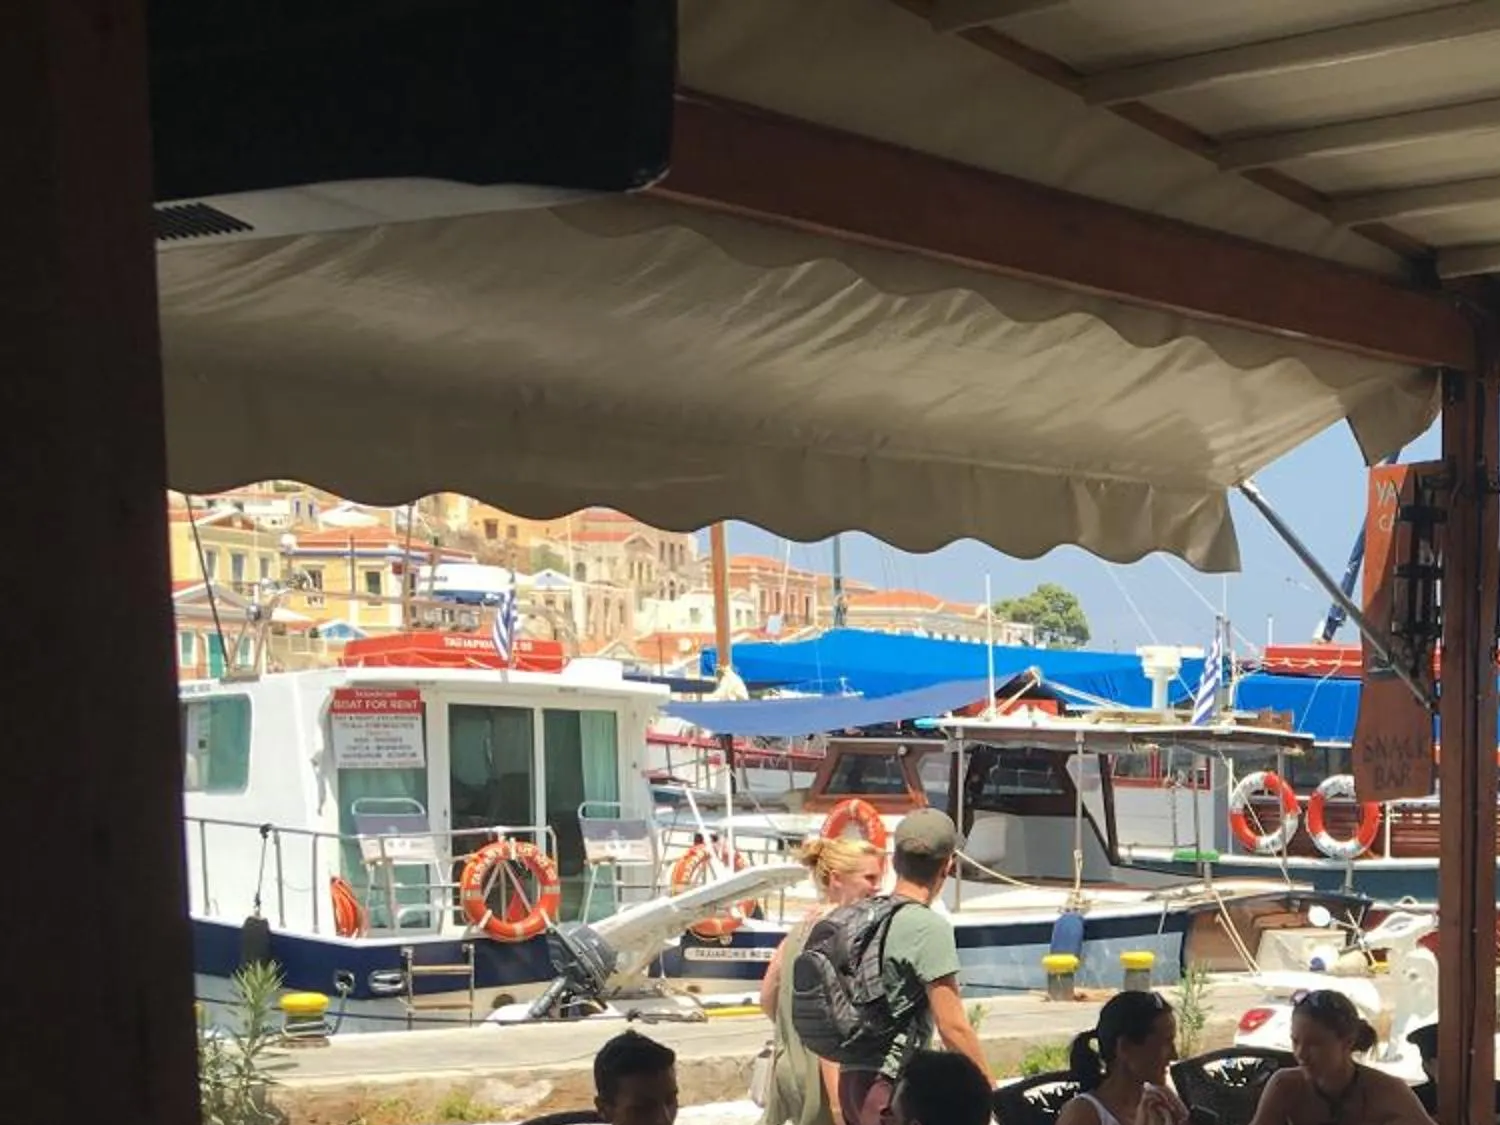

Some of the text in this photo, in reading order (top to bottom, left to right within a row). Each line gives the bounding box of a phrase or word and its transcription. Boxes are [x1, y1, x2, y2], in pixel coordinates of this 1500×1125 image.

[333, 699, 418, 710] BOAT FOR RENT
[1374, 764, 1412, 792] BAR
